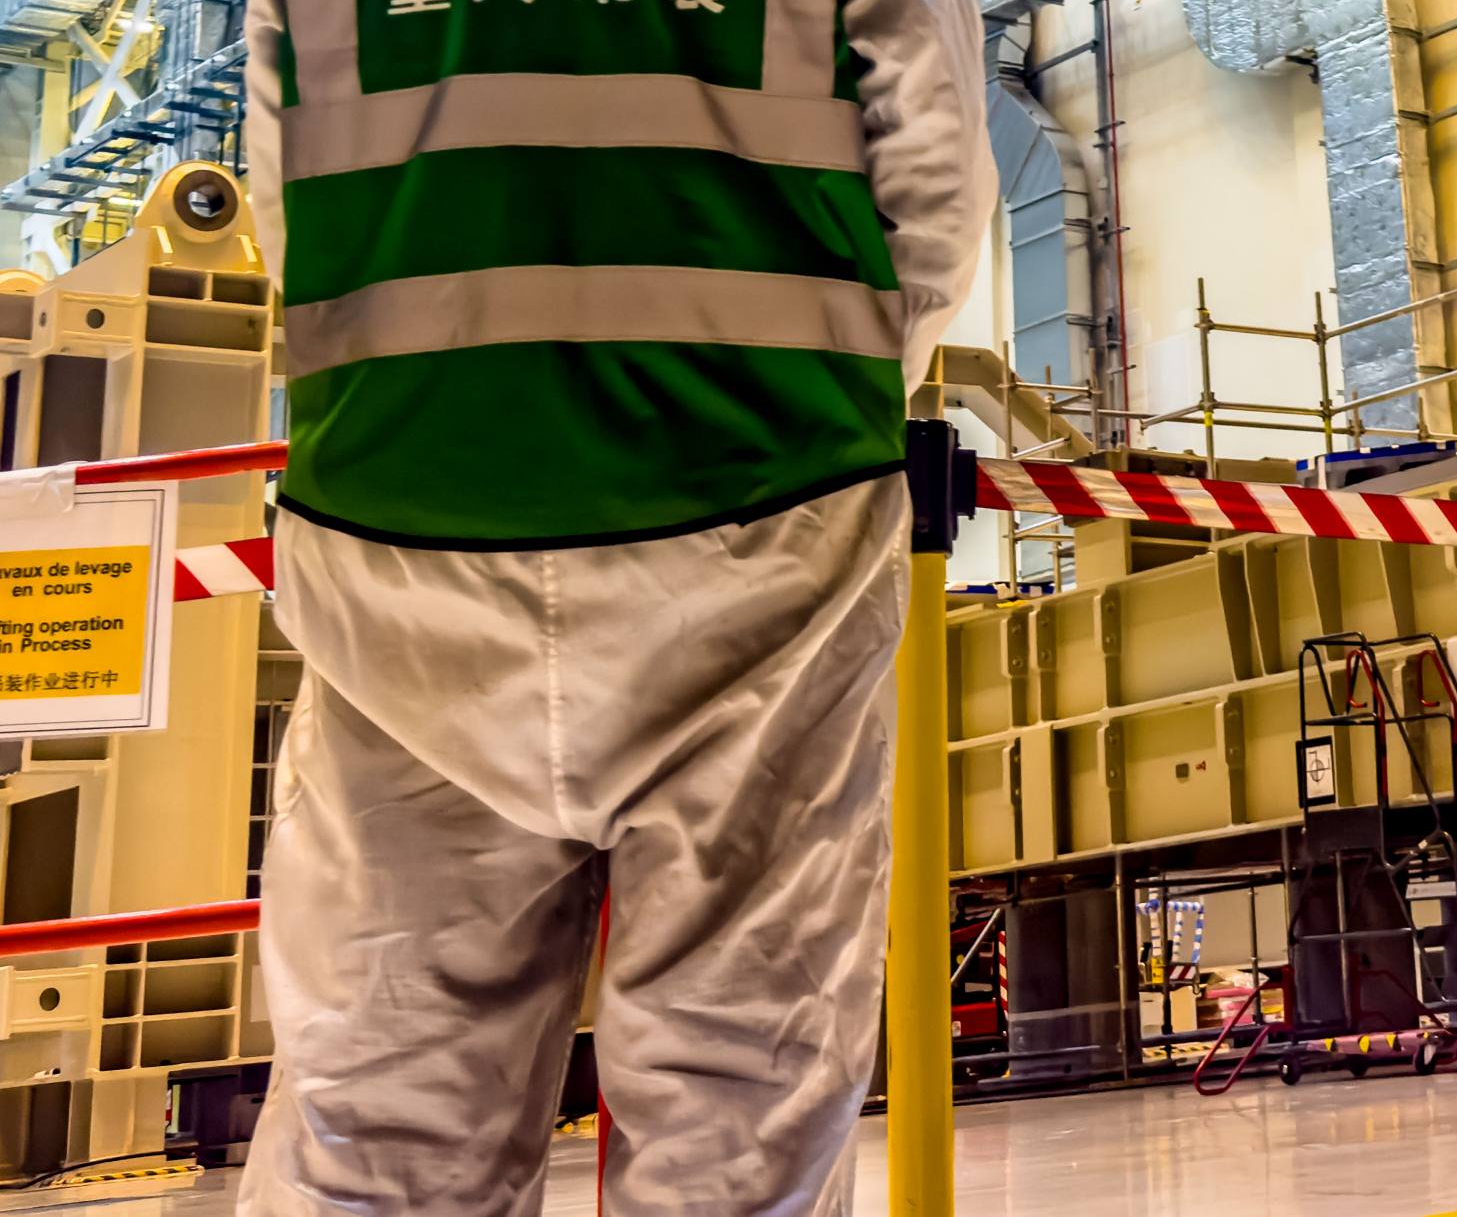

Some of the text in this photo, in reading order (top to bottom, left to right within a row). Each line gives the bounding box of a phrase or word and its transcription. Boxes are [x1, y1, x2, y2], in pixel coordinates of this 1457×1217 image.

[48, 562, 70, 577] de
[74, 561, 133, 578] levage
[12, 582, 93, 597] en cours
[39, 616, 124, 636] operation
[20, 638, 92, 653] Process
